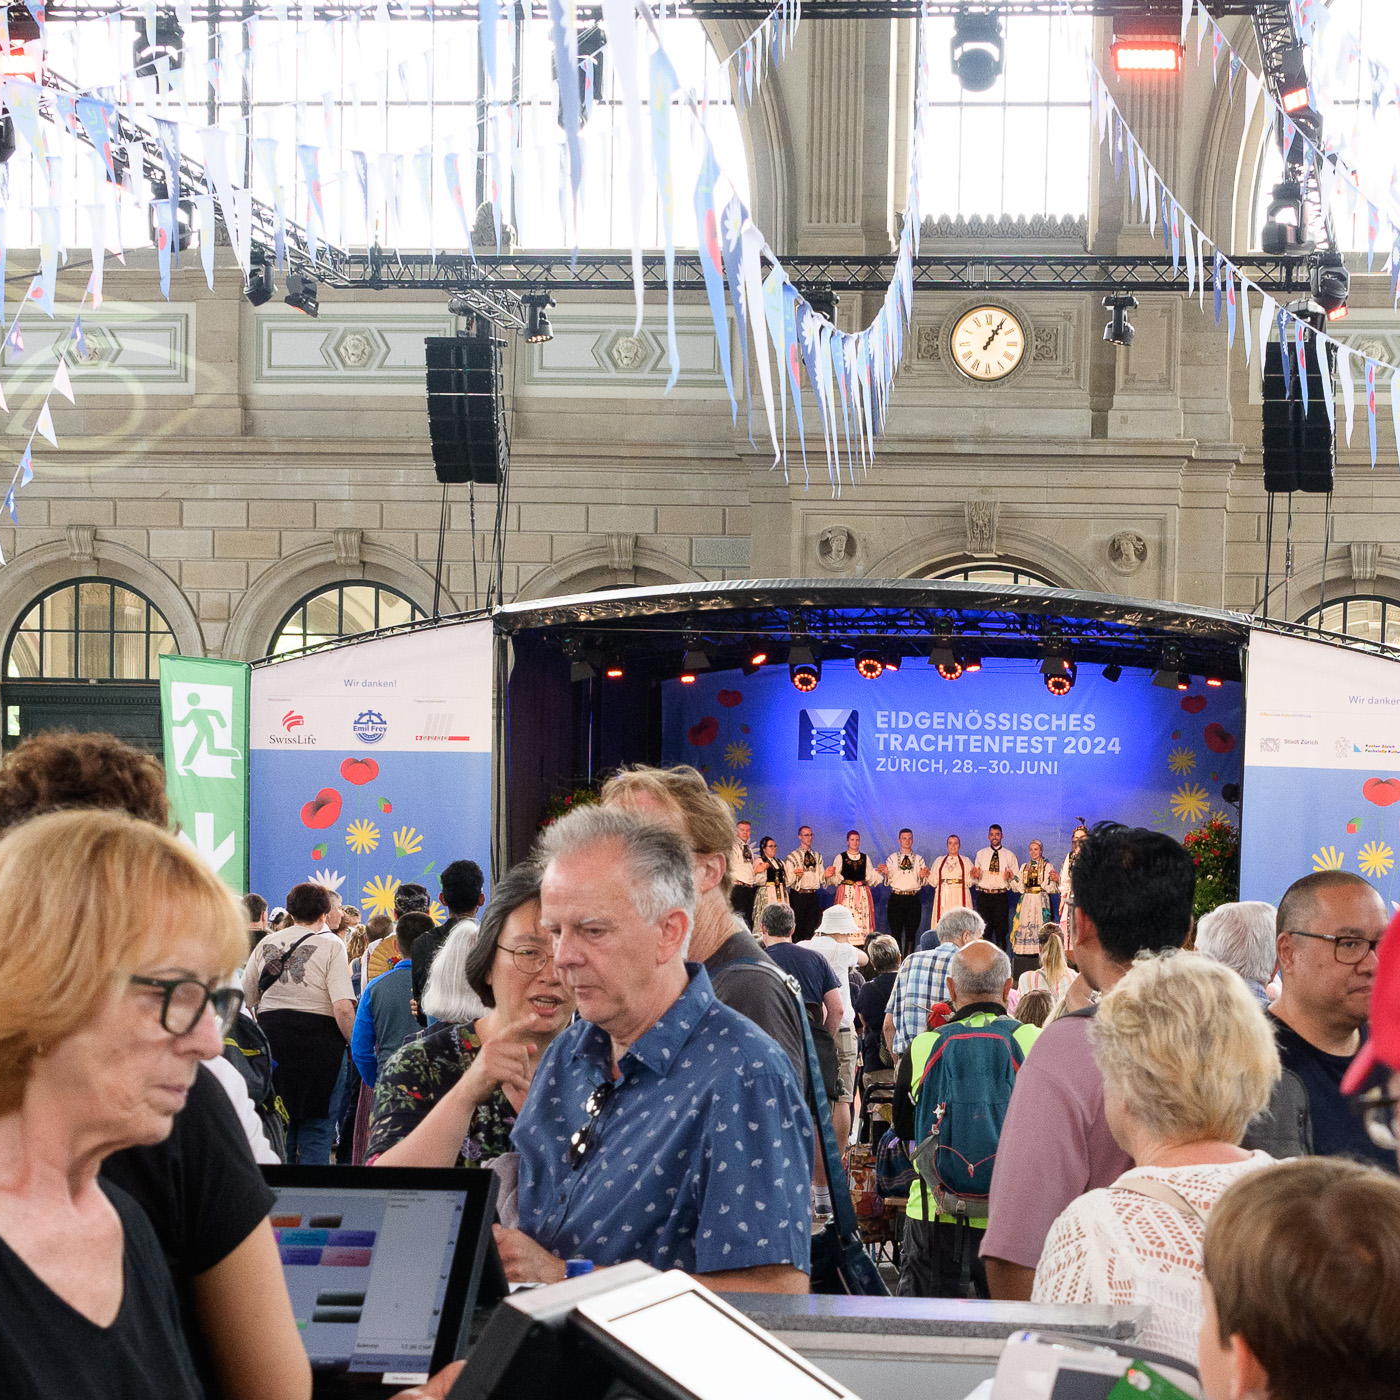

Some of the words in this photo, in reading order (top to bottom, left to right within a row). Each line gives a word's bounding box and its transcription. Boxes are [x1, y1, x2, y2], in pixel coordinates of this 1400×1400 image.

[343, 679, 359, 688] Wir
[361, 679, 397, 688] danken!
[1349, 695, 1365, 704] Wir
[876, 709, 1096, 731] EIDGENÖSSISCHES
[371, 725, 388, 734] Frey
[875, 733, 1057, 754] TRACHTENFEST
[1063, 736, 1122, 754] 2024
[1300, 738, 1319, 746] Zürich
[875, 756, 949, 775] ZÜRICH,
[1016, 760, 1058, 775] JUNI
